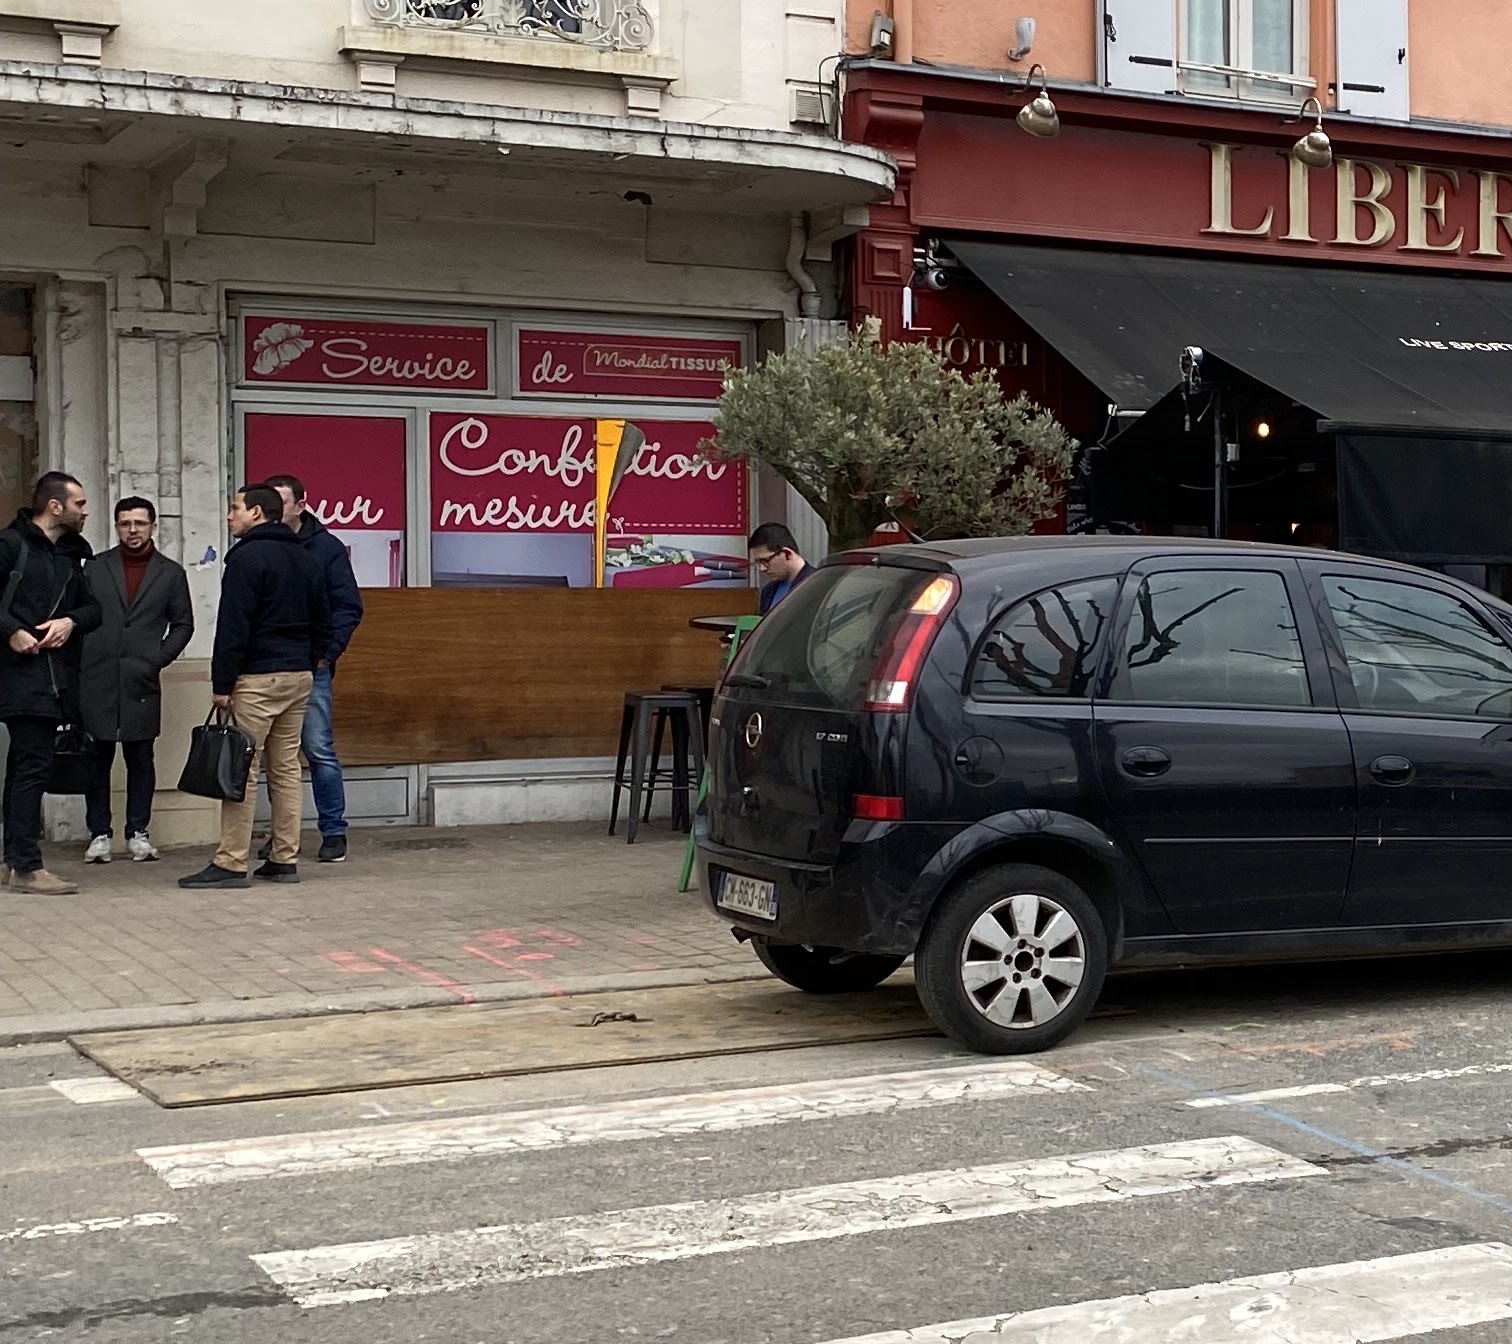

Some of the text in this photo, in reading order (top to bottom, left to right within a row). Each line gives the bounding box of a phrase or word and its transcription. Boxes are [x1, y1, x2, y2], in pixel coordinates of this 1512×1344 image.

[321, 338, 476, 380] Service
[1399, 337, 1448, 351] LIVE
[532, 350, 574, 384] de
